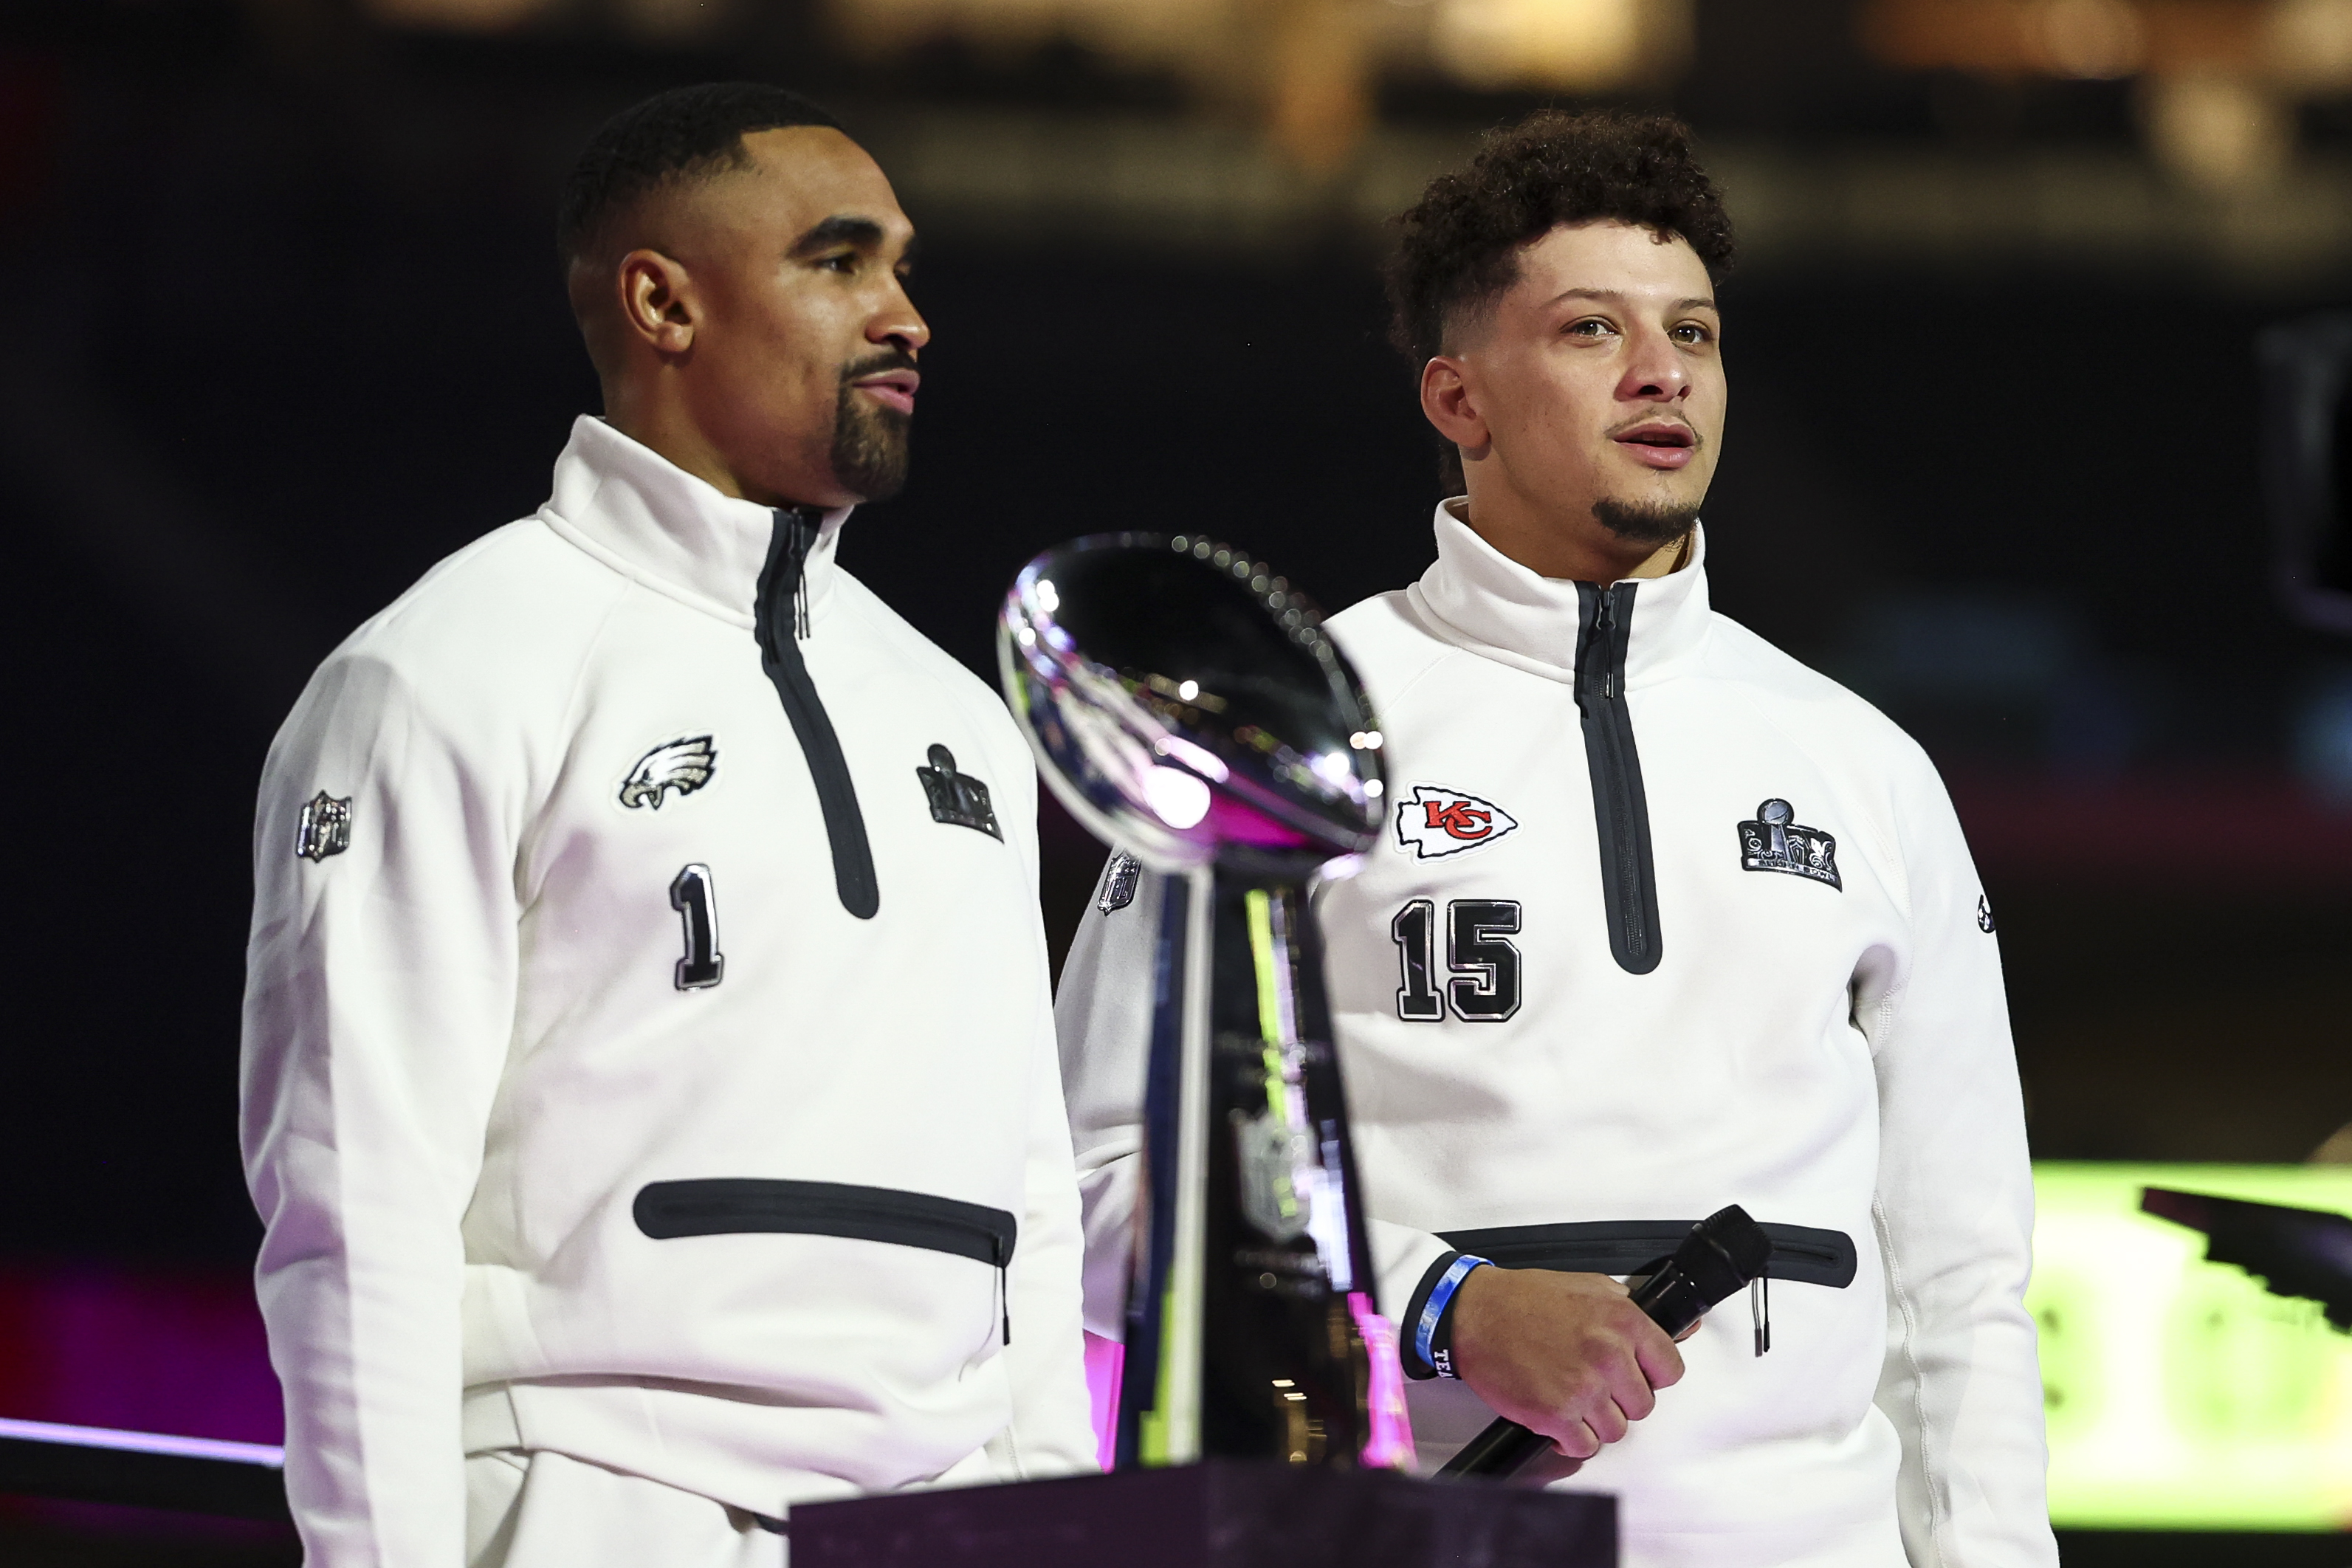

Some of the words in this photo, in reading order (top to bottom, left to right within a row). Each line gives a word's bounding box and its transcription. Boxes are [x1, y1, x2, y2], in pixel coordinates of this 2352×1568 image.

[1423, 800, 1493, 840] KC
[669, 864, 724, 990] 1
[1392, 899, 1521, 1022] 15
[1434, 1349, 1457, 1380] TEA
